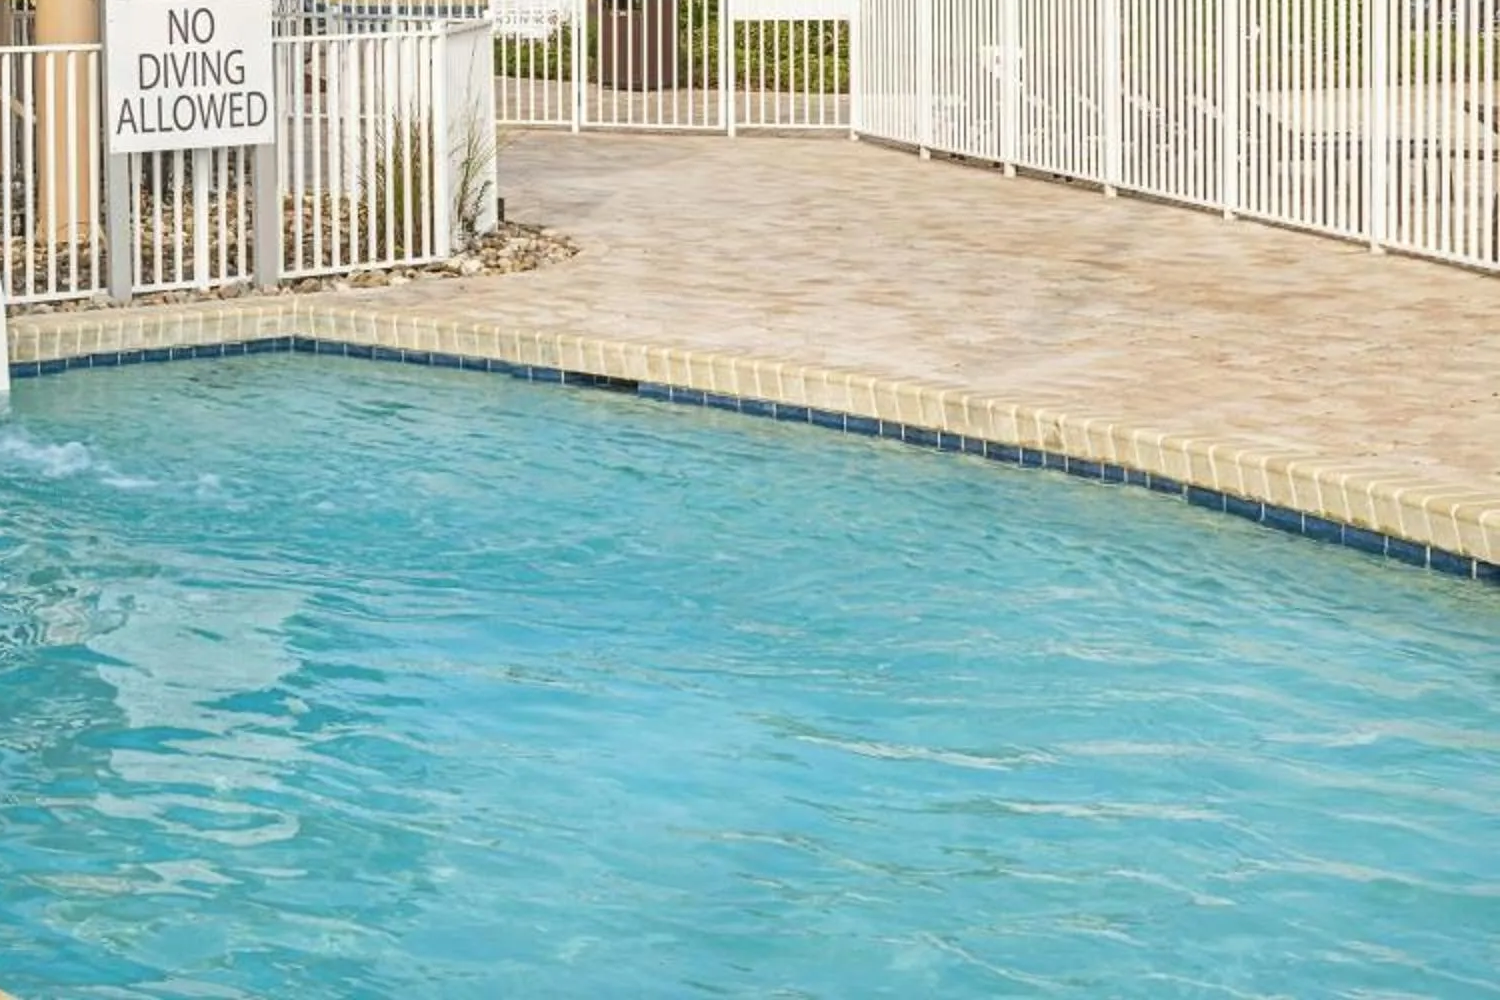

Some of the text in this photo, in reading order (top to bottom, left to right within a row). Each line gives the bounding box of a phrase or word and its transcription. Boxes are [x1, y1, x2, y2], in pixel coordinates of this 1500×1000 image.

[168, 8, 215, 45] NO
[138, 50, 245, 90] DIVING
[116, 91, 268, 134] ALLOWED
